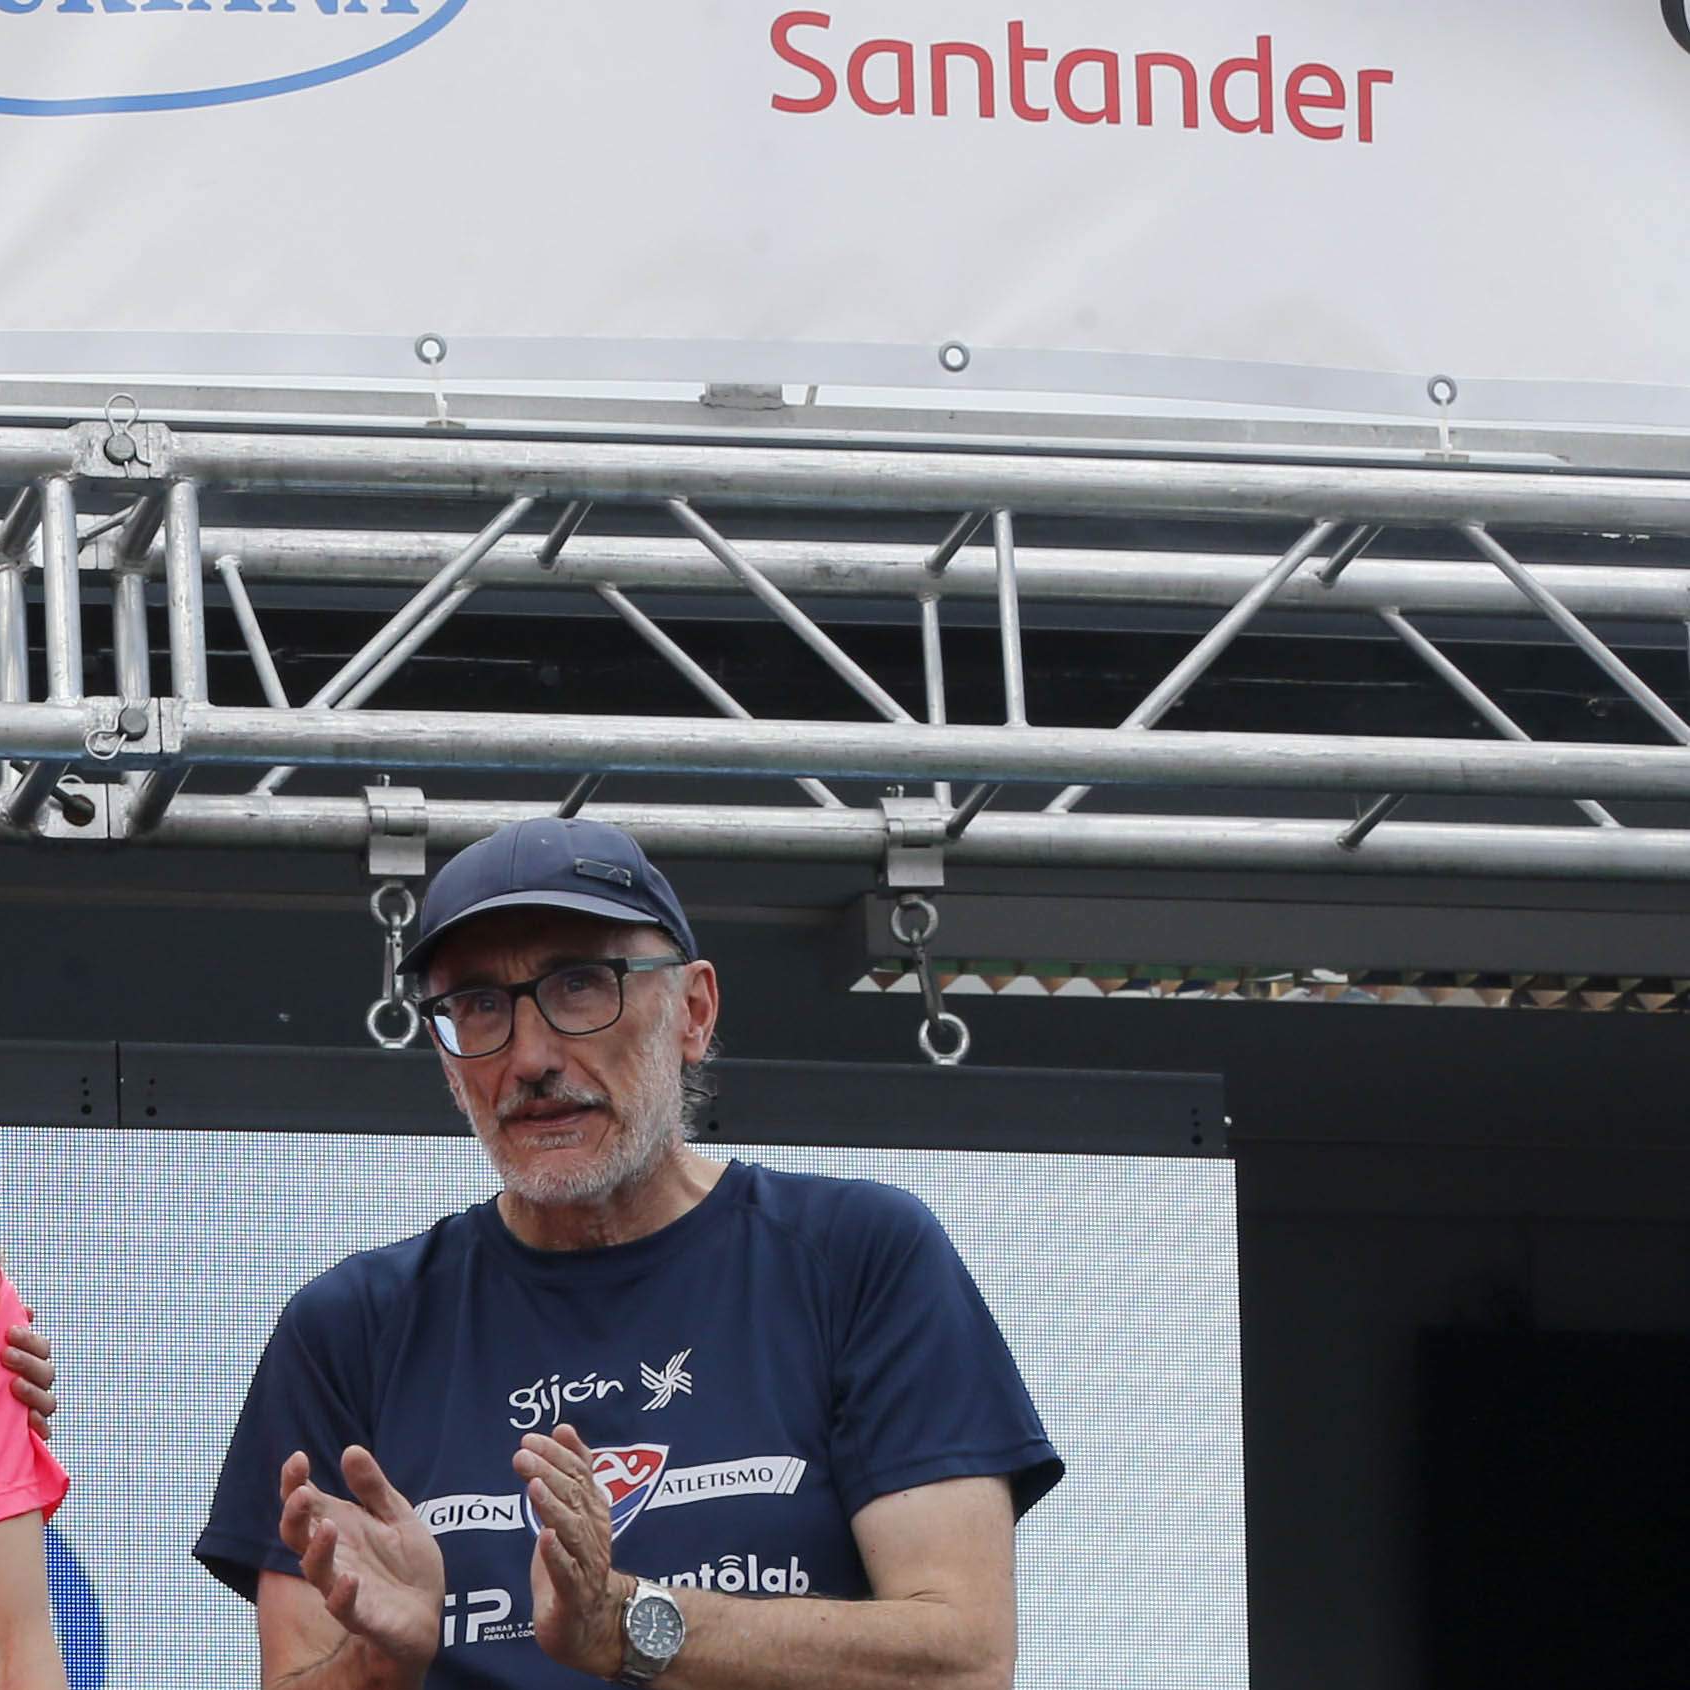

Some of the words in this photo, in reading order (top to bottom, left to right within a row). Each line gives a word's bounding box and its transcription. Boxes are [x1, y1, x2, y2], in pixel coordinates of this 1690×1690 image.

[769, 10, 1393, 143] Santander
[508, 1372, 625, 1430] gijón
[660, 1467, 774, 1497] ATLETISMO
[429, 1498, 515, 1527] GIJÓN
[484, 1623, 513, 1634] OBRAS
[484, 1633, 505, 1642] PARA
[507, 1632, 517, 1640] LA
